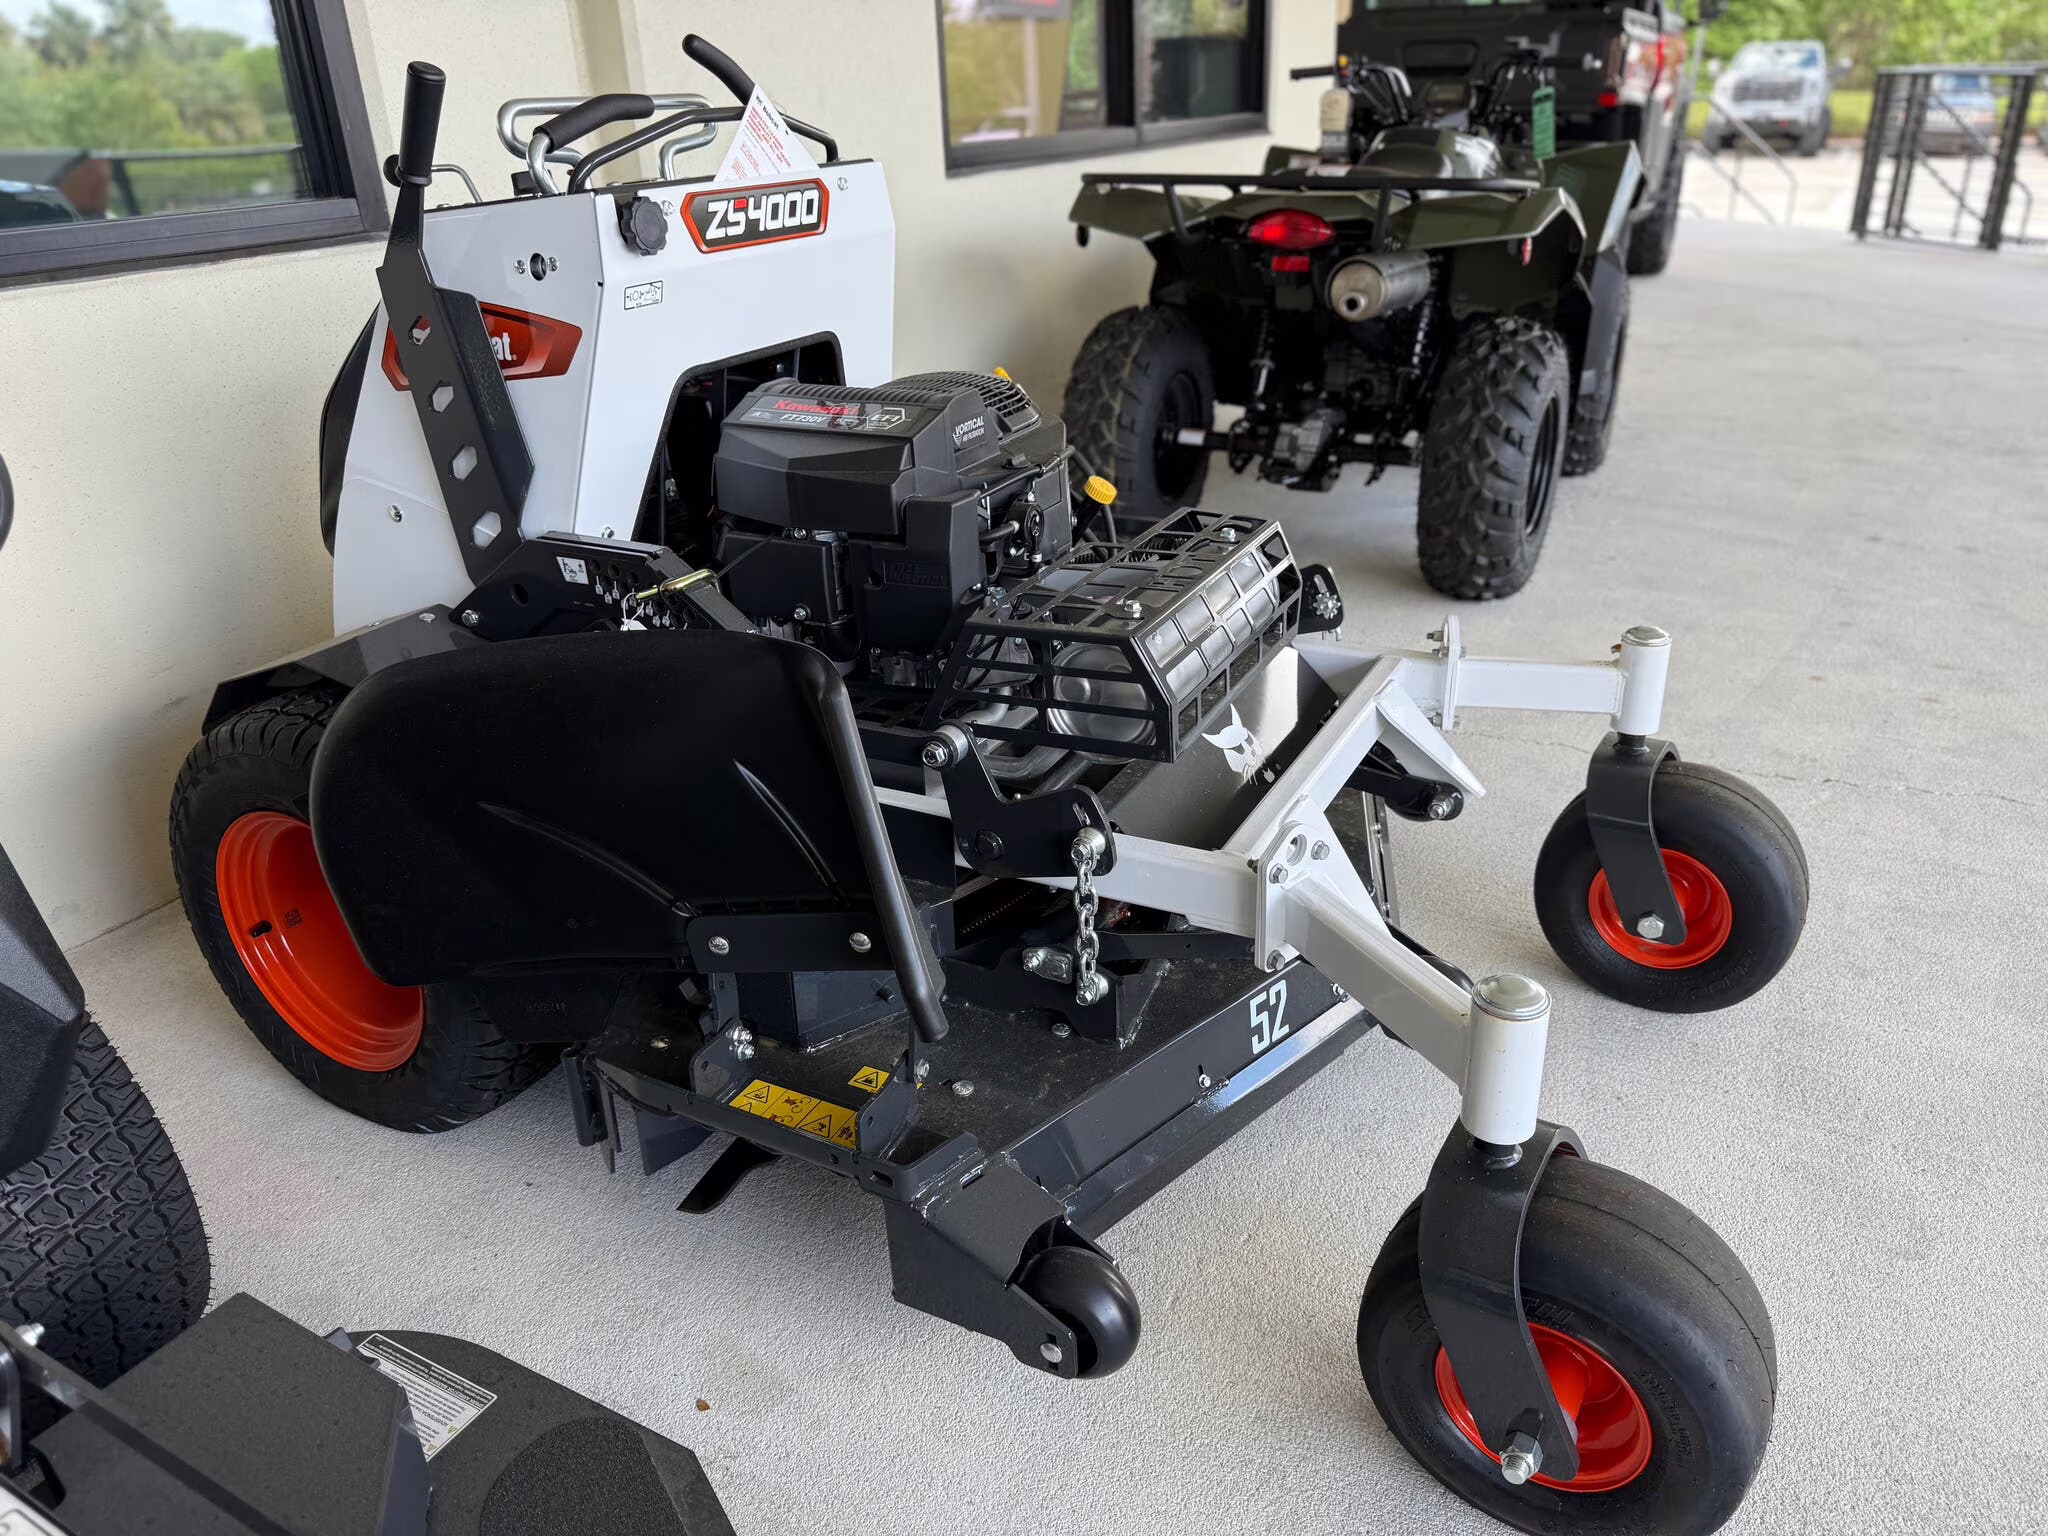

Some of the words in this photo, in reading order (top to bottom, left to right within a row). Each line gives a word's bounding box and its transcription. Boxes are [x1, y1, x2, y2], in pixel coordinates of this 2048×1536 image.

[705, 188, 820, 241] ZS4000
[773, 399, 860, 415] Kawasaki
[779, 413, 828, 424] FT730V
[870, 414, 902, 422] EFI
[955, 415, 984, 436] VORTICAL
[1250, 979, 1290, 1055] 52
